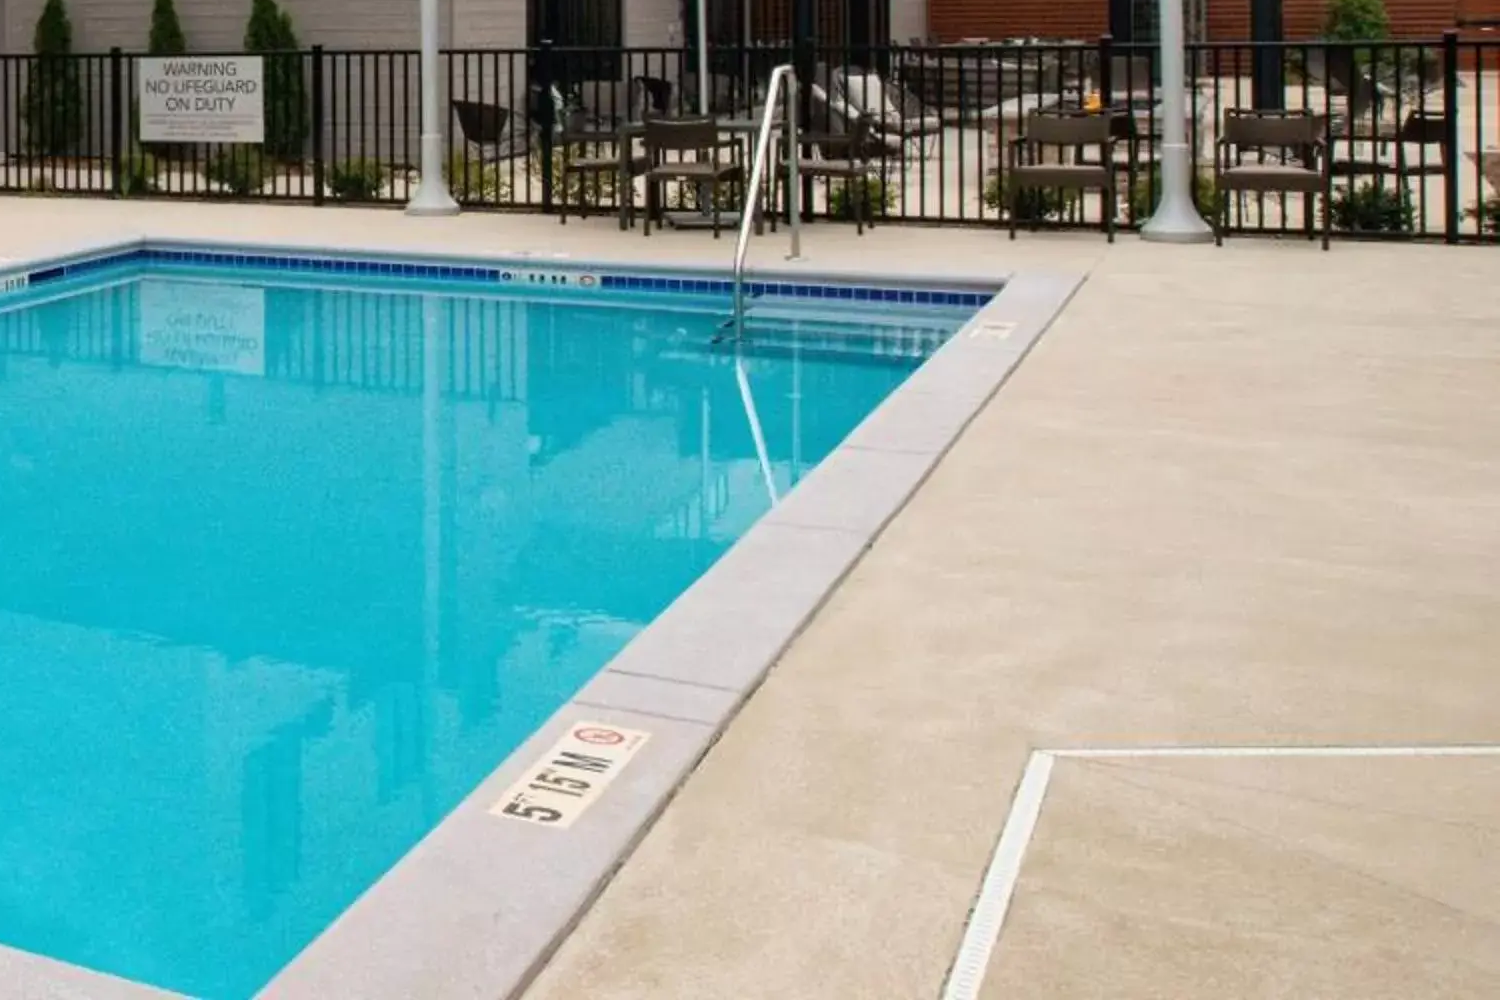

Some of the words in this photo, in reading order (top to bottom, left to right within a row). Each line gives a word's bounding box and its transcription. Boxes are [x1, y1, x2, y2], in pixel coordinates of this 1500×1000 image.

[164, 62, 237, 77] WARNING
[145, 80, 170, 95] NO
[173, 79, 257, 95] LIFEGUARD
[165, 97, 190, 112] ON
[194, 97, 236, 112] DUTY
[502, 803, 563, 822] 5
[553, 752, 613, 773] M
